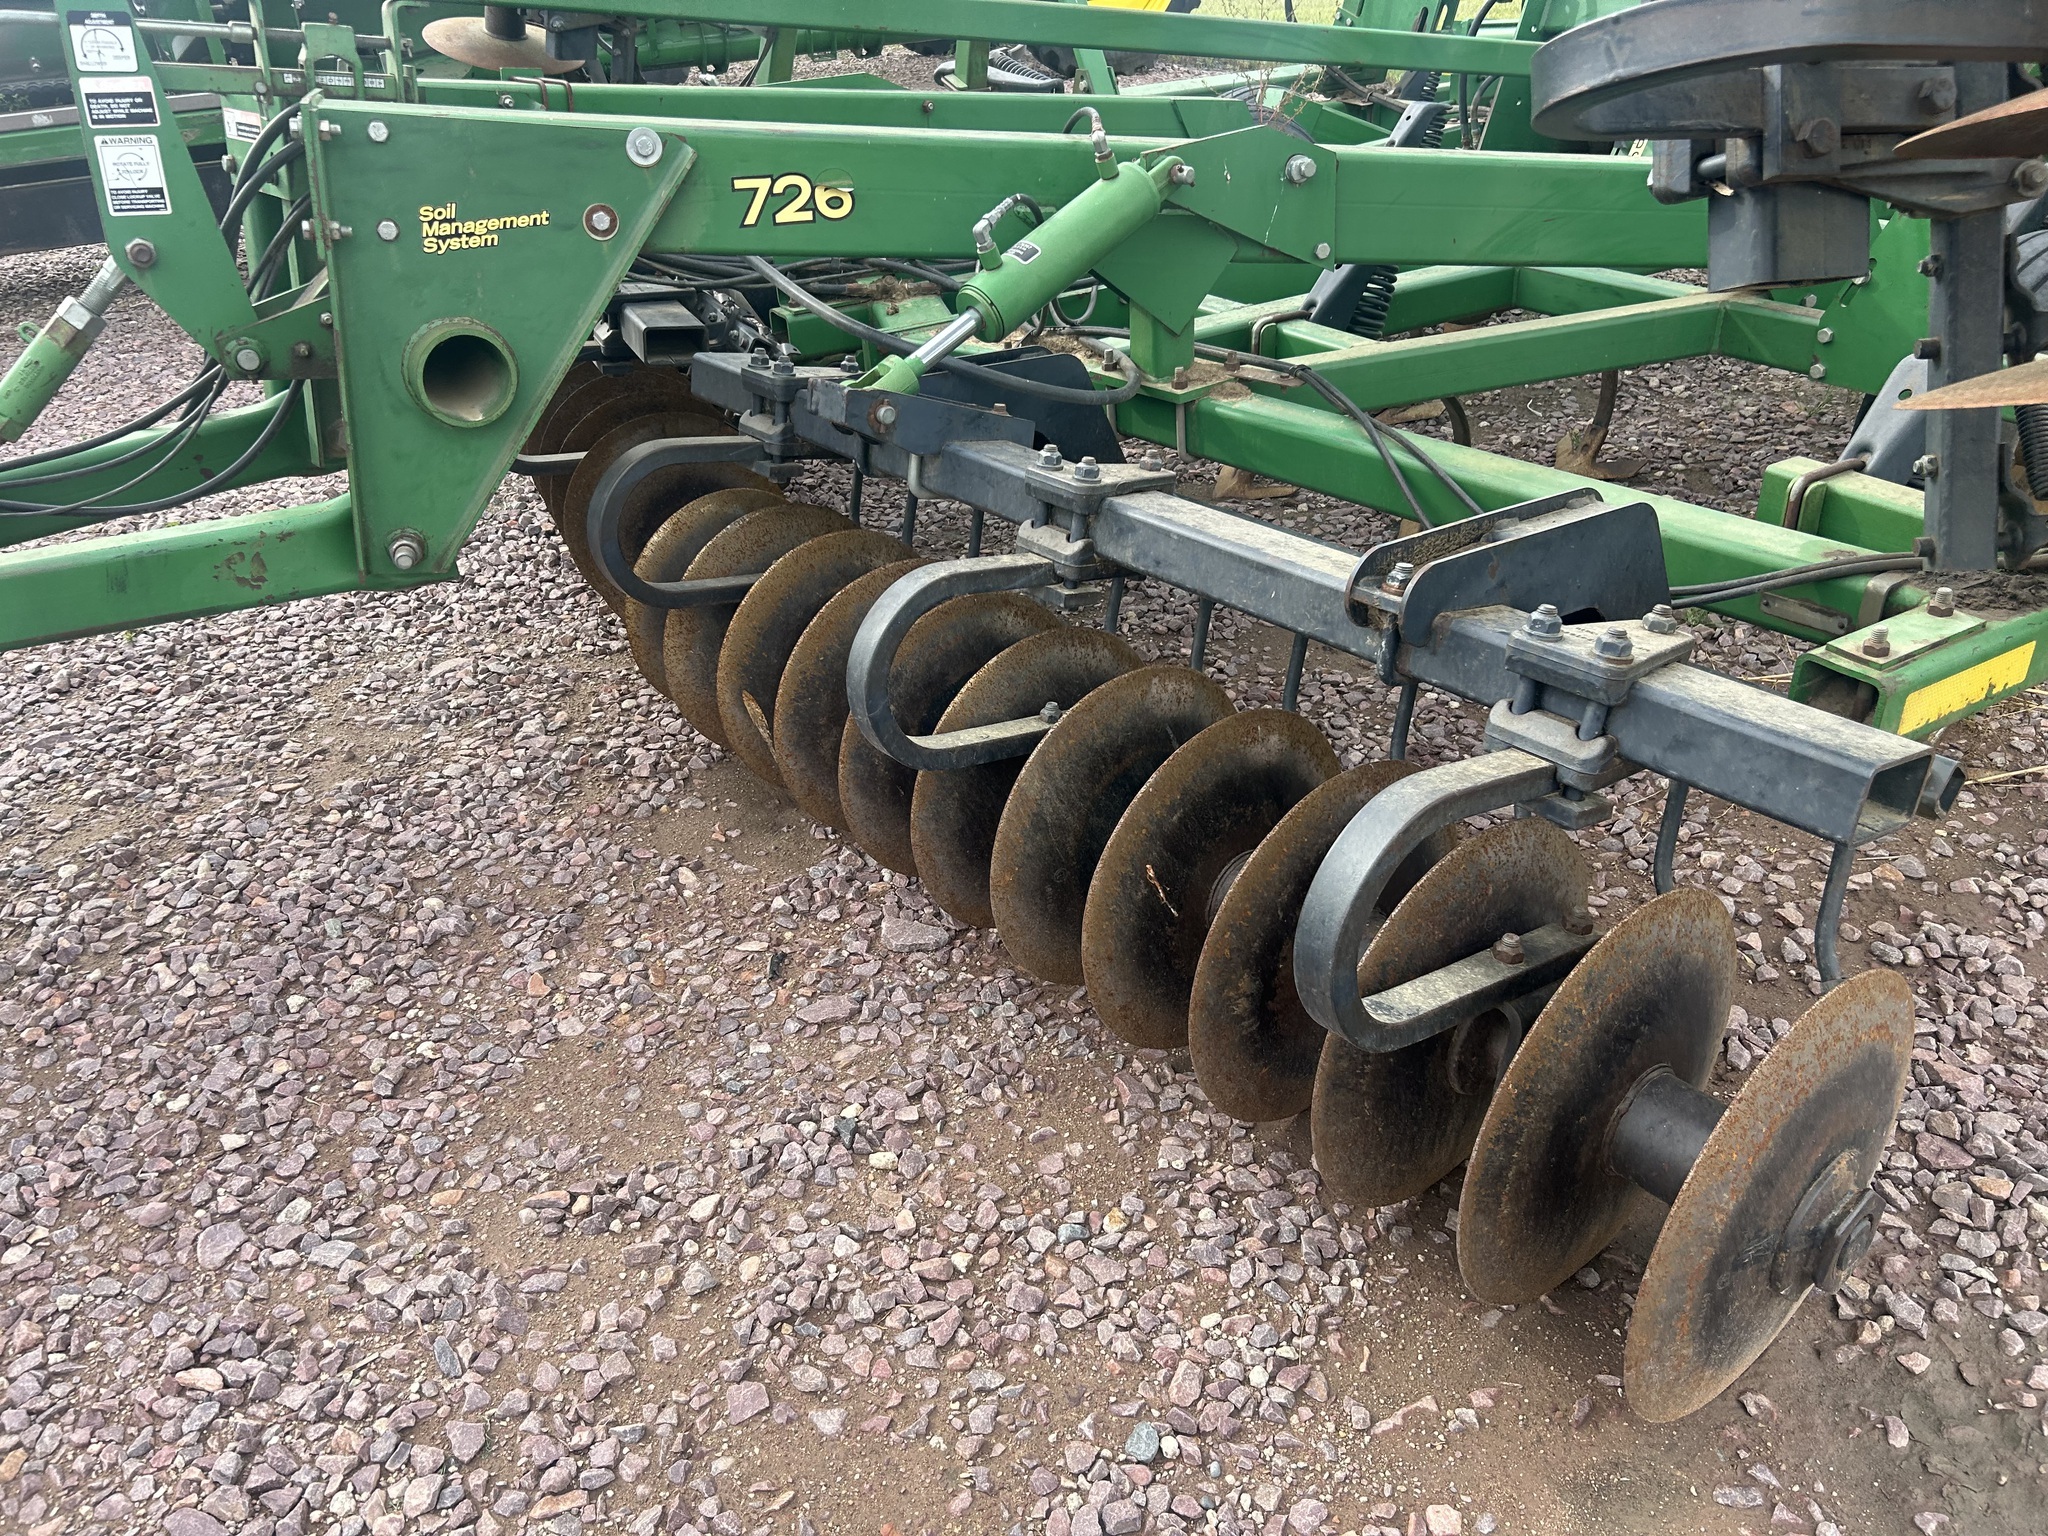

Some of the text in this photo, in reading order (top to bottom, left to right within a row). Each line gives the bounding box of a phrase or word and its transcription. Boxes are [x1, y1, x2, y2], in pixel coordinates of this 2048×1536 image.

[419, 202, 456, 222] Soil
[731, 172, 855, 228] 726
[422, 210, 550, 238] Management
[423, 234, 499, 255] System
